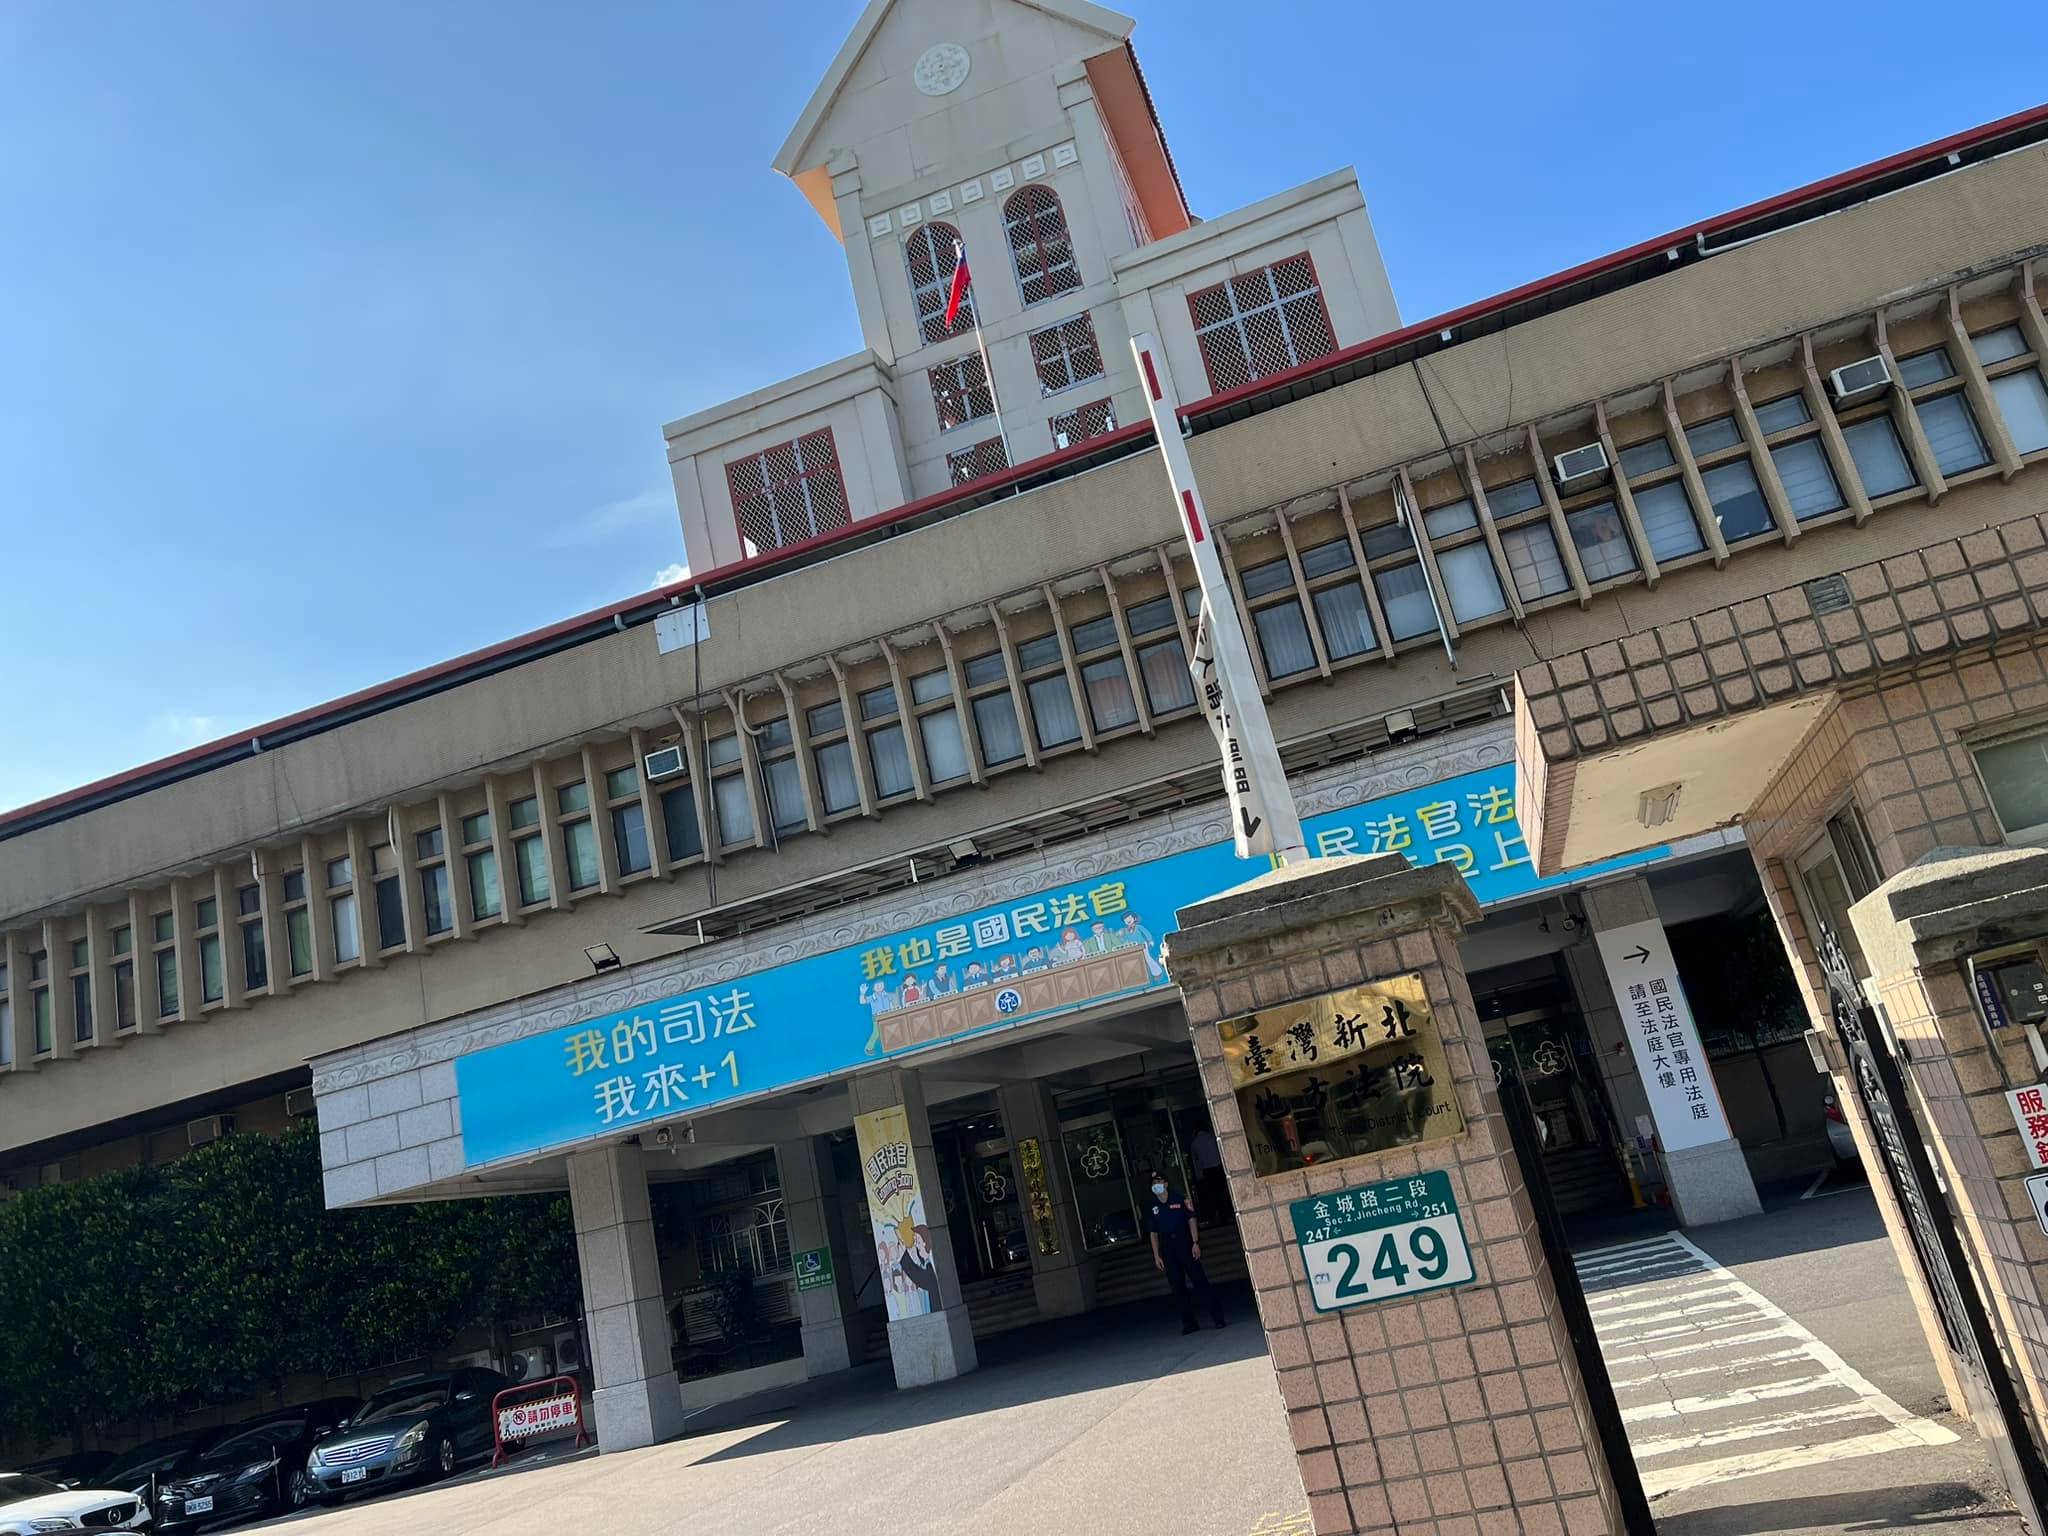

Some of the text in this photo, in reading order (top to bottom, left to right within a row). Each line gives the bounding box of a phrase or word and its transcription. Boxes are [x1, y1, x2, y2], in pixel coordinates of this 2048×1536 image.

[1271, 786, 1514, 872] 民法官法
[1403, 831, 1531, 878] 旦上
[860, 880, 1128, 981] 我也是國民法官
[564, 988, 757, 1077] 我的司法
[1244, 1000, 1417, 1076] 臺灣新北
[1628, 984, 1676, 1089] 請至法庭大樓
[1650, 977, 1711, 1121] 國民法官專用法庭
[1256, 1053, 1434, 1119] 地方法院
[865, 1141, 908, 1183] 國民法官
[1313, 1180, 1428, 1219] 金城路二段
[1405, 1199, 1422, 1213] Rd.
[1422, 1201, 1449, 1219] 251
[1306, 1226, 1331, 1243] 247
[1326, 1225, 1450, 1299] 249
[527, 1400, 573, 1428] 請勿停車
